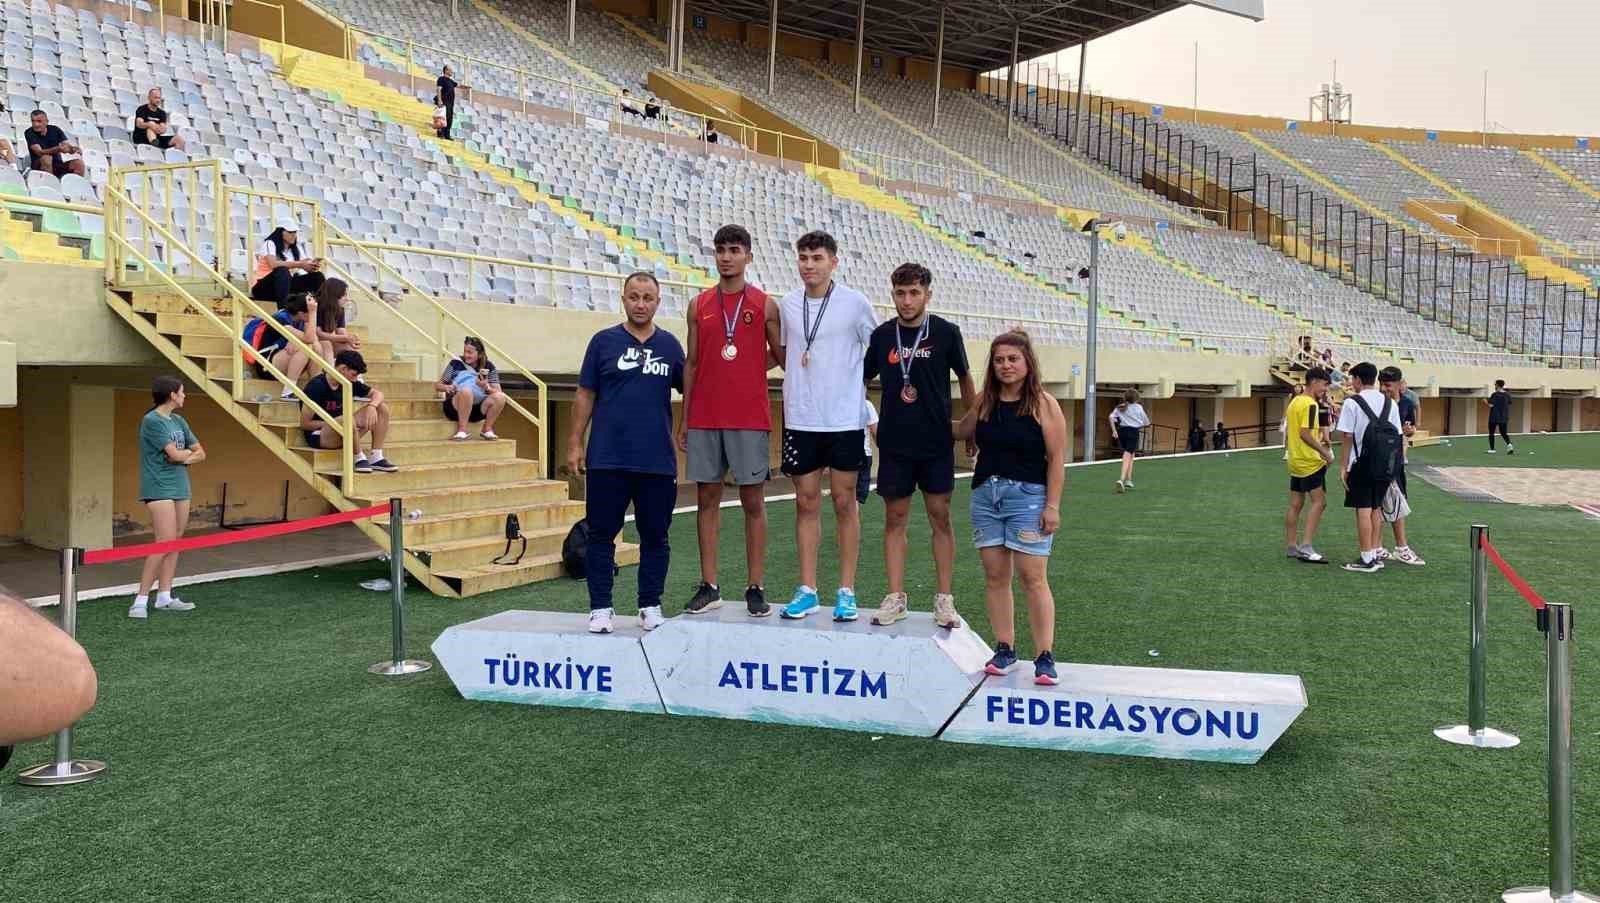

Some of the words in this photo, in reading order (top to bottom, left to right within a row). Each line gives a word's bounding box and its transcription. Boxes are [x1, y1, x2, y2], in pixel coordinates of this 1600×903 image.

[624, 347, 653, 362] JUT
[484, 653, 612, 692] TÜRKİYE
[718, 660, 888, 699] ATLETİZM
[986, 695, 1259, 740] FEDERASYONU
